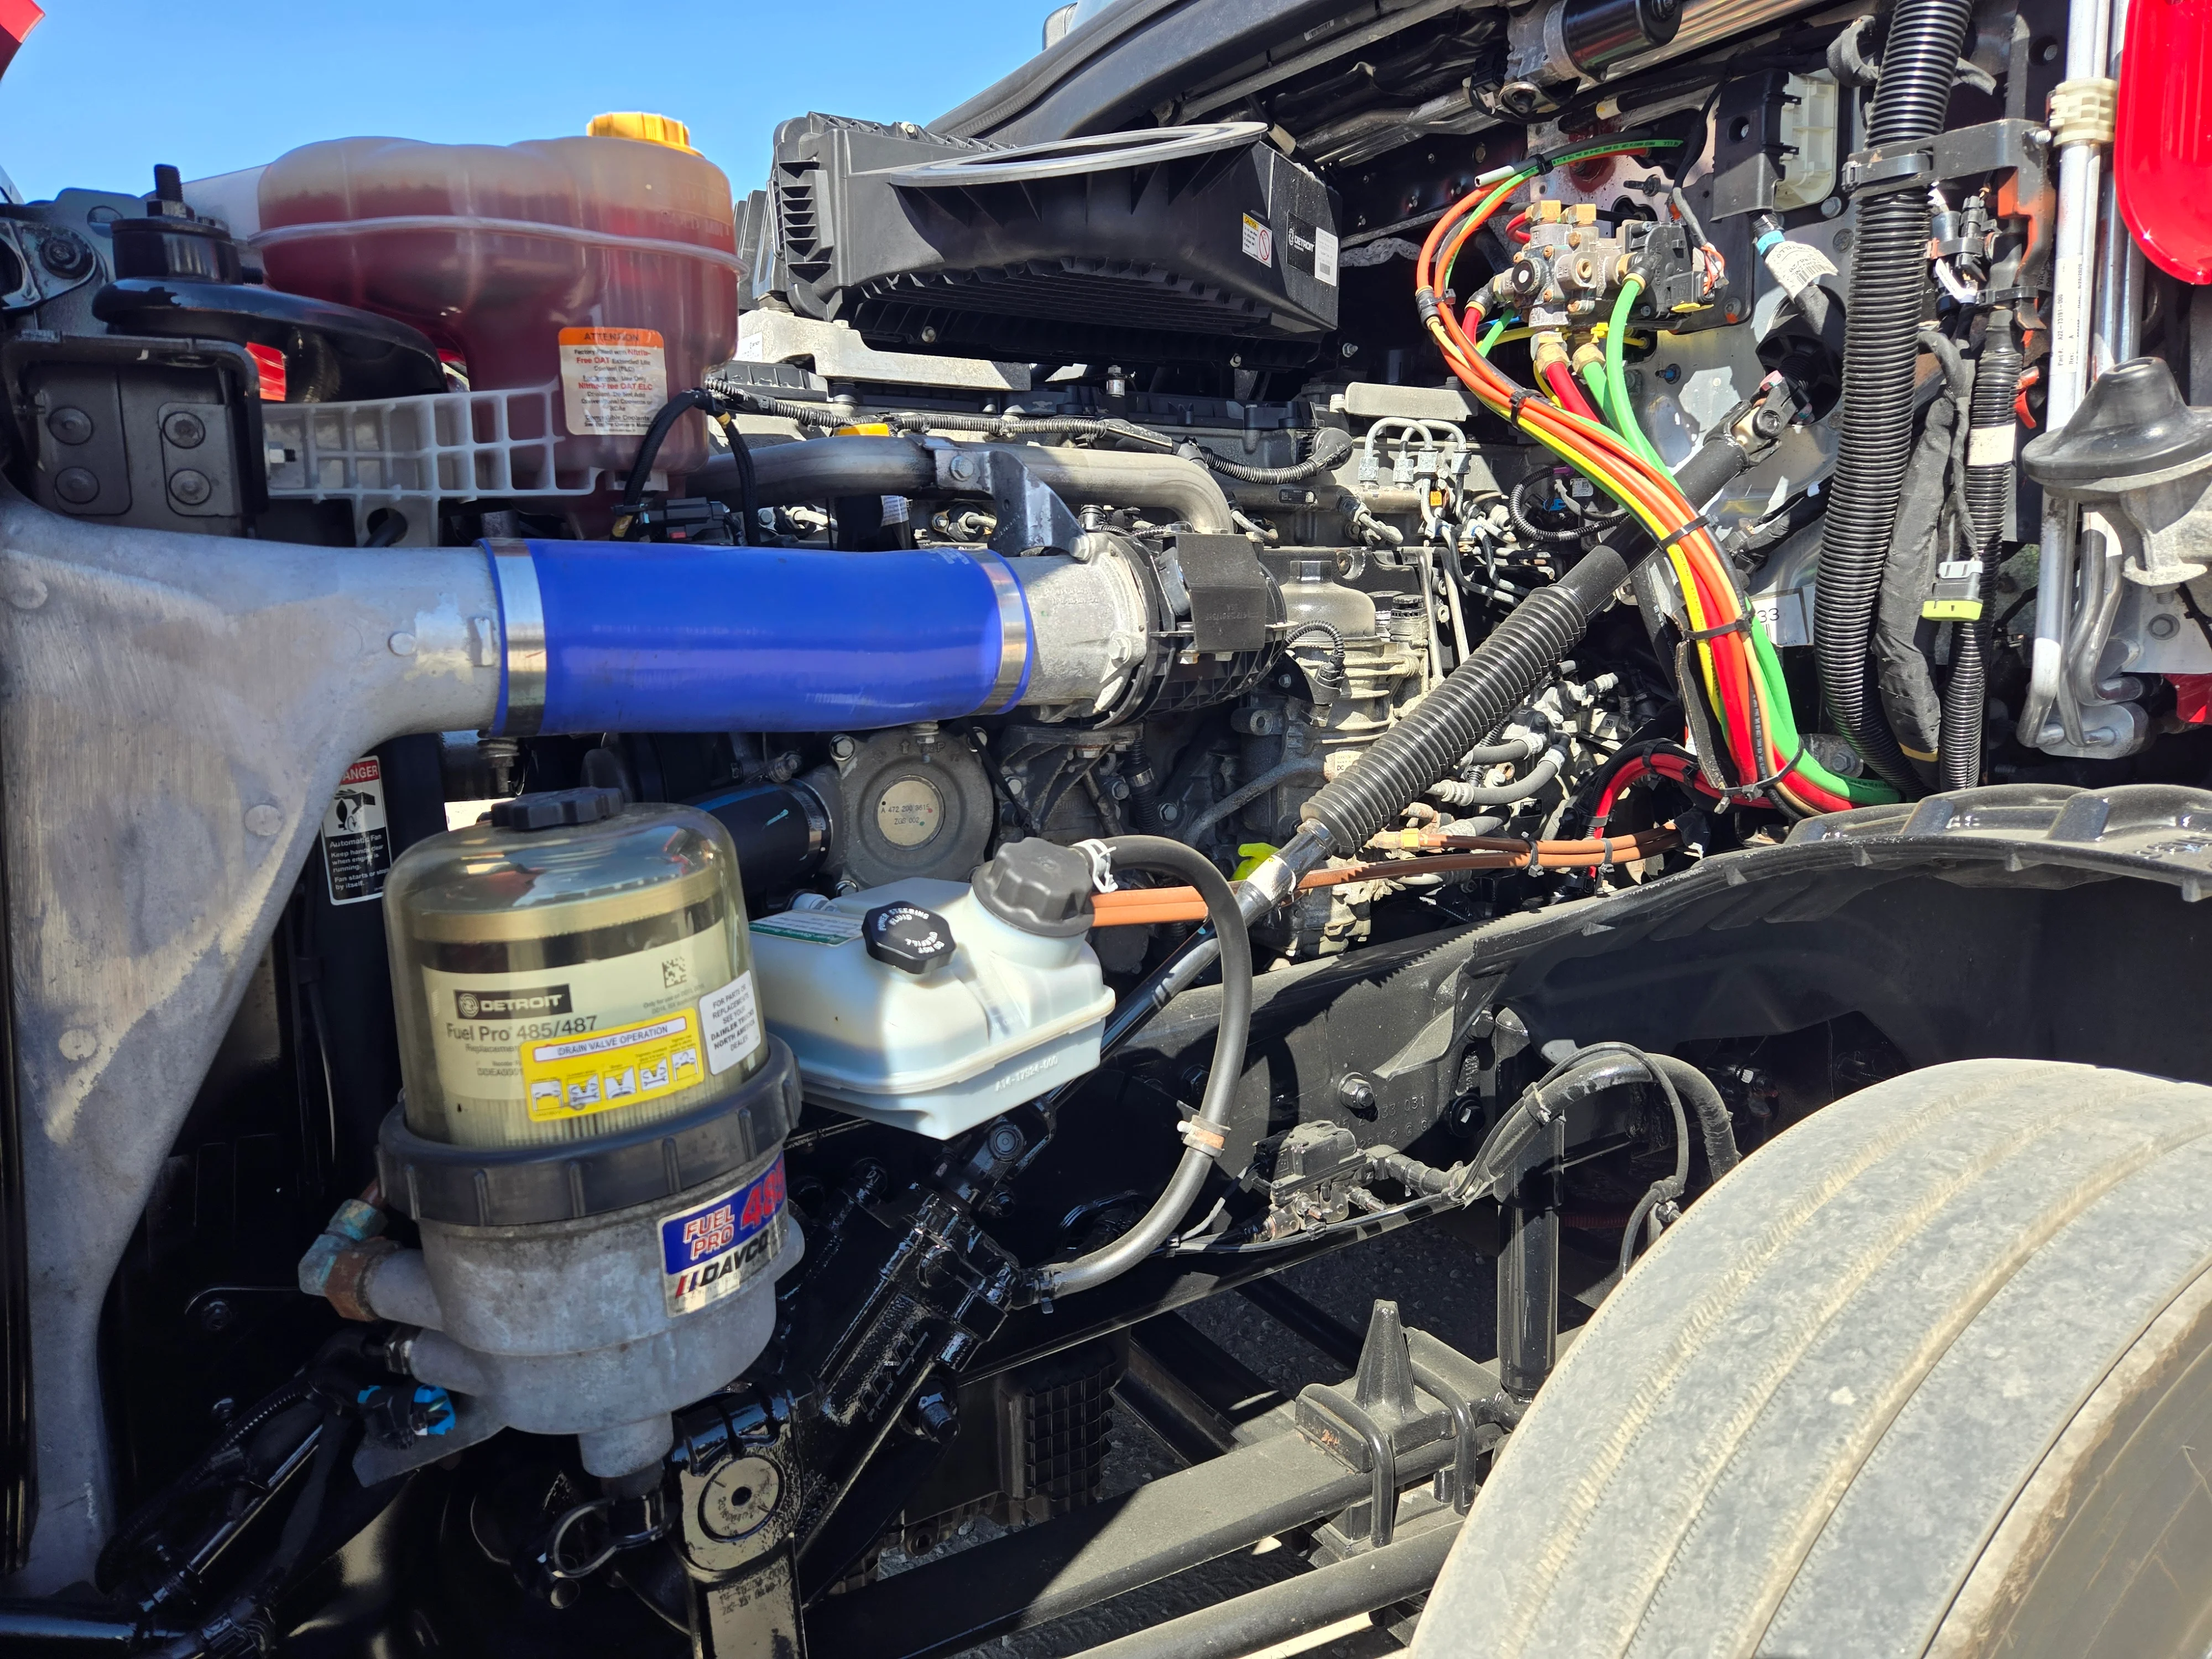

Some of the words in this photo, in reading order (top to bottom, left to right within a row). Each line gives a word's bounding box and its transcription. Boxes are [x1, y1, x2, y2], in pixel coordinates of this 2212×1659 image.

[1295, 235, 1314, 252] DETROIT
[585, 332, 639, 341] ATTENTION
[1757, 608, 1780, 623] 33
[342, 765, 378, 781] ANGER
[330, 837, 369, 848] Automatic
[333, 864, 362, 873] running.
[877, 913, 889, 931] POWER
[888, 907, 930, 920] STEERING
[889, 914, 912, 926] FLUID
[905, 931, 938, 947] OVERFILL
[933, 941, 945, 950] DO
[917, 946, 935, 954] NOT
[481, 994, 562, 1012] DETROIT
[712, 993, 749, 1019] REPLACEMENTS
[713, 999, 725, 1009] FOR
[726, 990, 740, 1001] PARTS
[723, 1015, 734, 1024] SEE
[734, 1006, 746, 1018] YOUR
[446, 1022, 474, 1041] Fuel
[479, 1025, 510, 1042] Pro
[517, 1014, 597, 1040] 485/487
[711, 1022, 738, 1041] DAIMLER
[714, 1031, 736, 1050] NORTH
[737, 1018, 755, 1035] AMERICA
[557, 1044, 587, 1056] DRAIN
[589, 1038, 618, 1051] VALVE
[619, 1025, 669, 1044] OPERATION
[731, 1035, 749, 1051] DEALER
[1405, 1094, 1425, 1112] 031
[683, 1204, 735, 1244] FUEL
[690, 1224, 734, 1261] PRO
[700, 1229, 769, 1287] DAVCO
